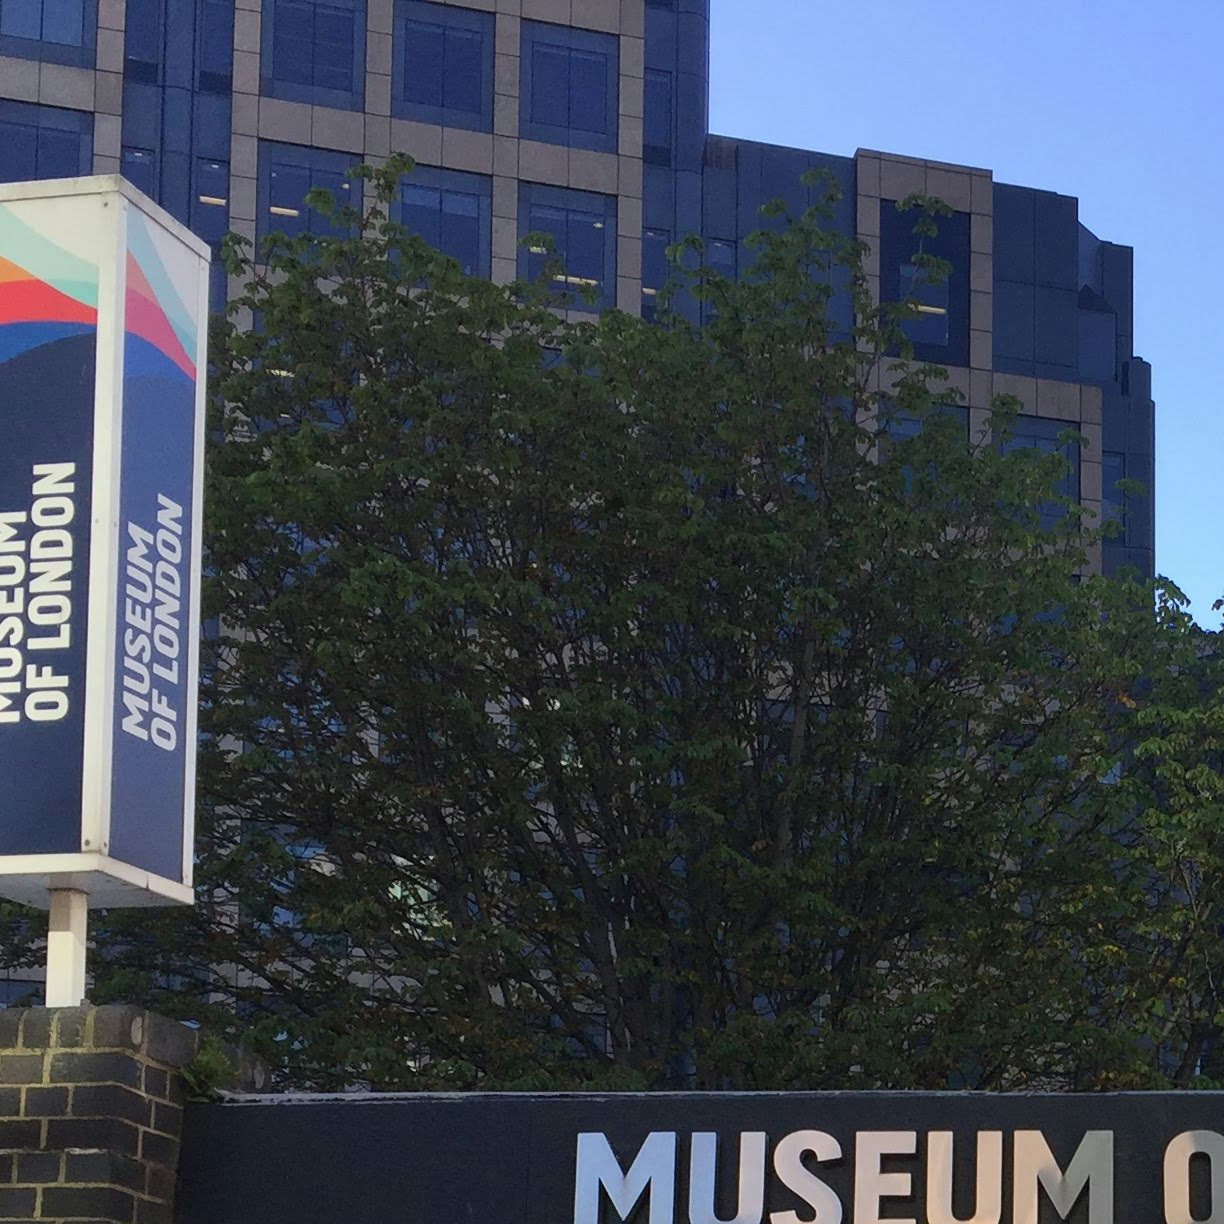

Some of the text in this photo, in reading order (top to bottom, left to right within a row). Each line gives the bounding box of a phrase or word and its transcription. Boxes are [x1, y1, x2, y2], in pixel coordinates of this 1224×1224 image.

[24, 462, 76, 722] OF LONDON
[121, 521, 155, 741] MUSEUM
[150, 493, 184, 752] OF LONDON
